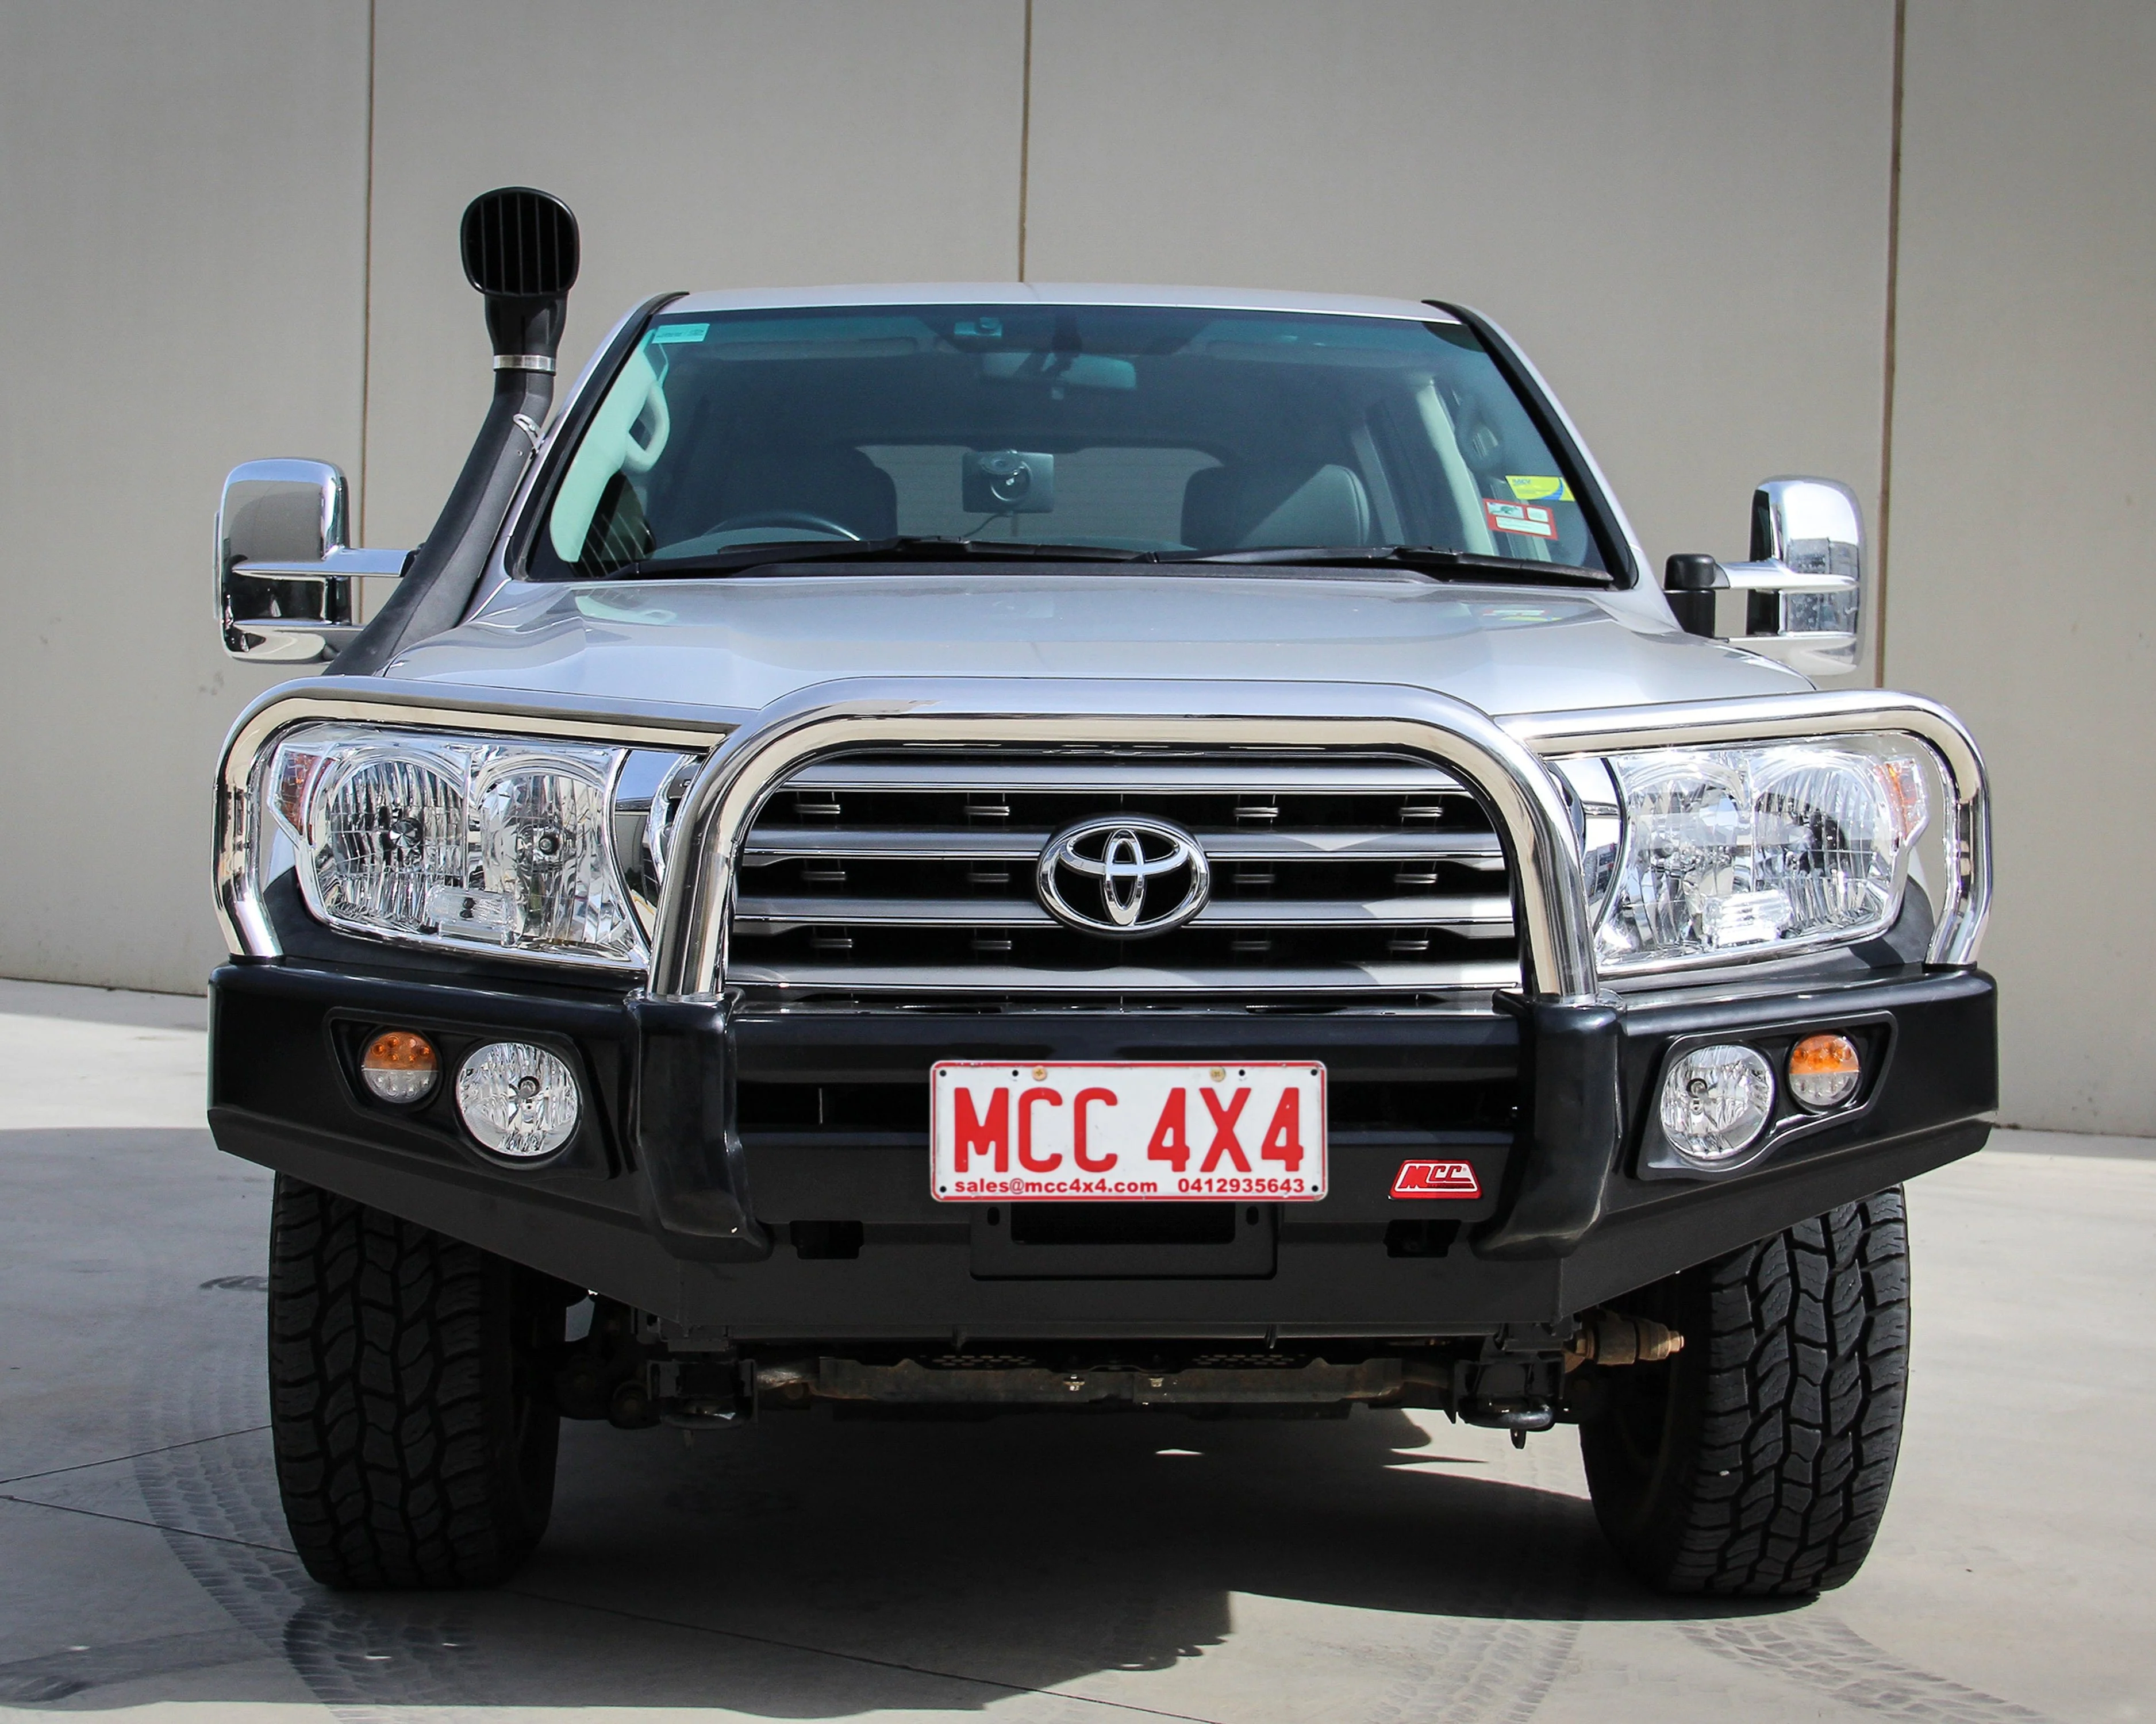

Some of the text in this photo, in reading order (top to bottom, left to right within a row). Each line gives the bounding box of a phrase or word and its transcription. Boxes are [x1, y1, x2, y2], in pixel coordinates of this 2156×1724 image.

[954, 1087, 1304, 1173] MCC 4X4
[955, 1178, 1305, 1194] sales@mcc4x4.com 0412935643
[1397, 1165, 1471, 1189] MCC
